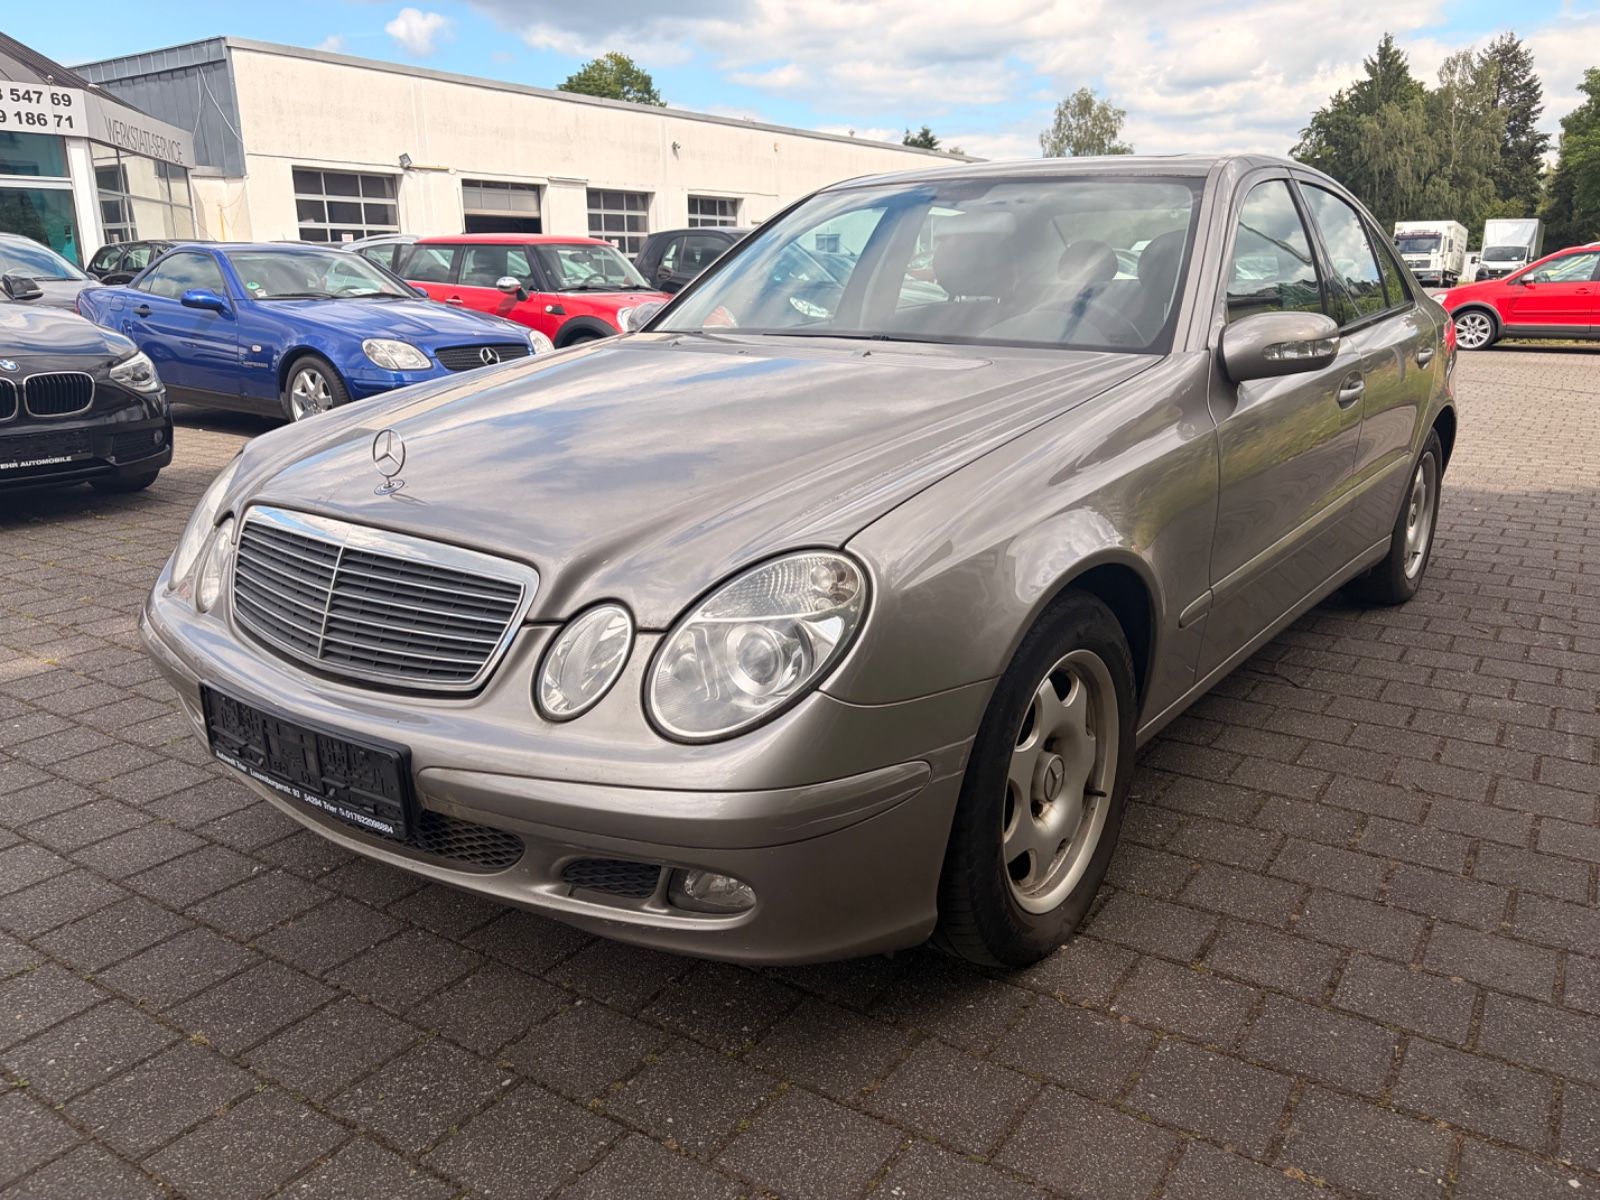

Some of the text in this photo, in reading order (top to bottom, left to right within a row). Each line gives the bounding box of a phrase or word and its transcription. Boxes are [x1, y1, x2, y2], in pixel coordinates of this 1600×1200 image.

[10, 88, 43, 104] 547
[50, 92, 72, 107] 69
[14, 110, 48, 127] 186
[53, 114, 73, 129] 71
[103, 115, 183, 165] WERKSTATT-SERVICE
[20, 456, 72, 468] AUTOMOBILE
[323, 800, 337, 814] Trier
